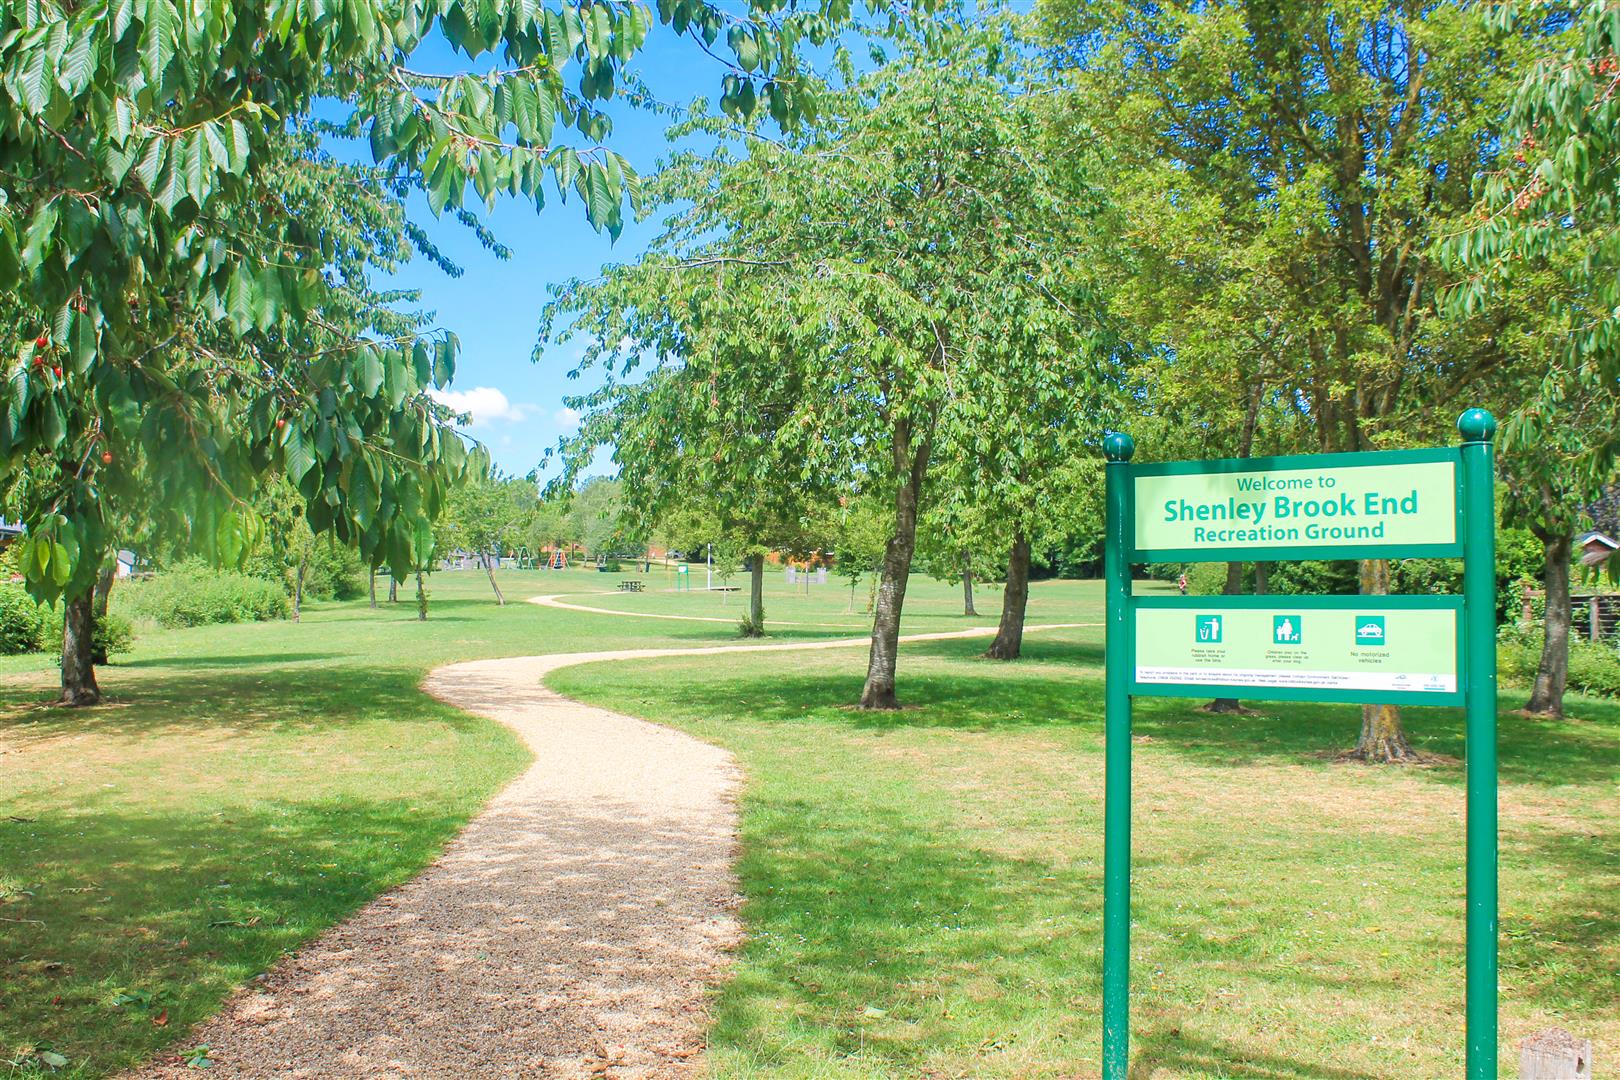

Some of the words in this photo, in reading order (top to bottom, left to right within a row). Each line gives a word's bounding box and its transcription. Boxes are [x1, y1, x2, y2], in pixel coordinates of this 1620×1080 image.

[1237, 476, 1313, 492] Welcome
[1318, 475, 1336, 489] to
[1164, 497, 1267, 525] Shenley
[1274, 493, 1357, 519] Brook
[1364, 490, 1418, 516] End
[1194, 524, 1299, 543] Recreation
[1305, 521, 1385, 540] Ground
